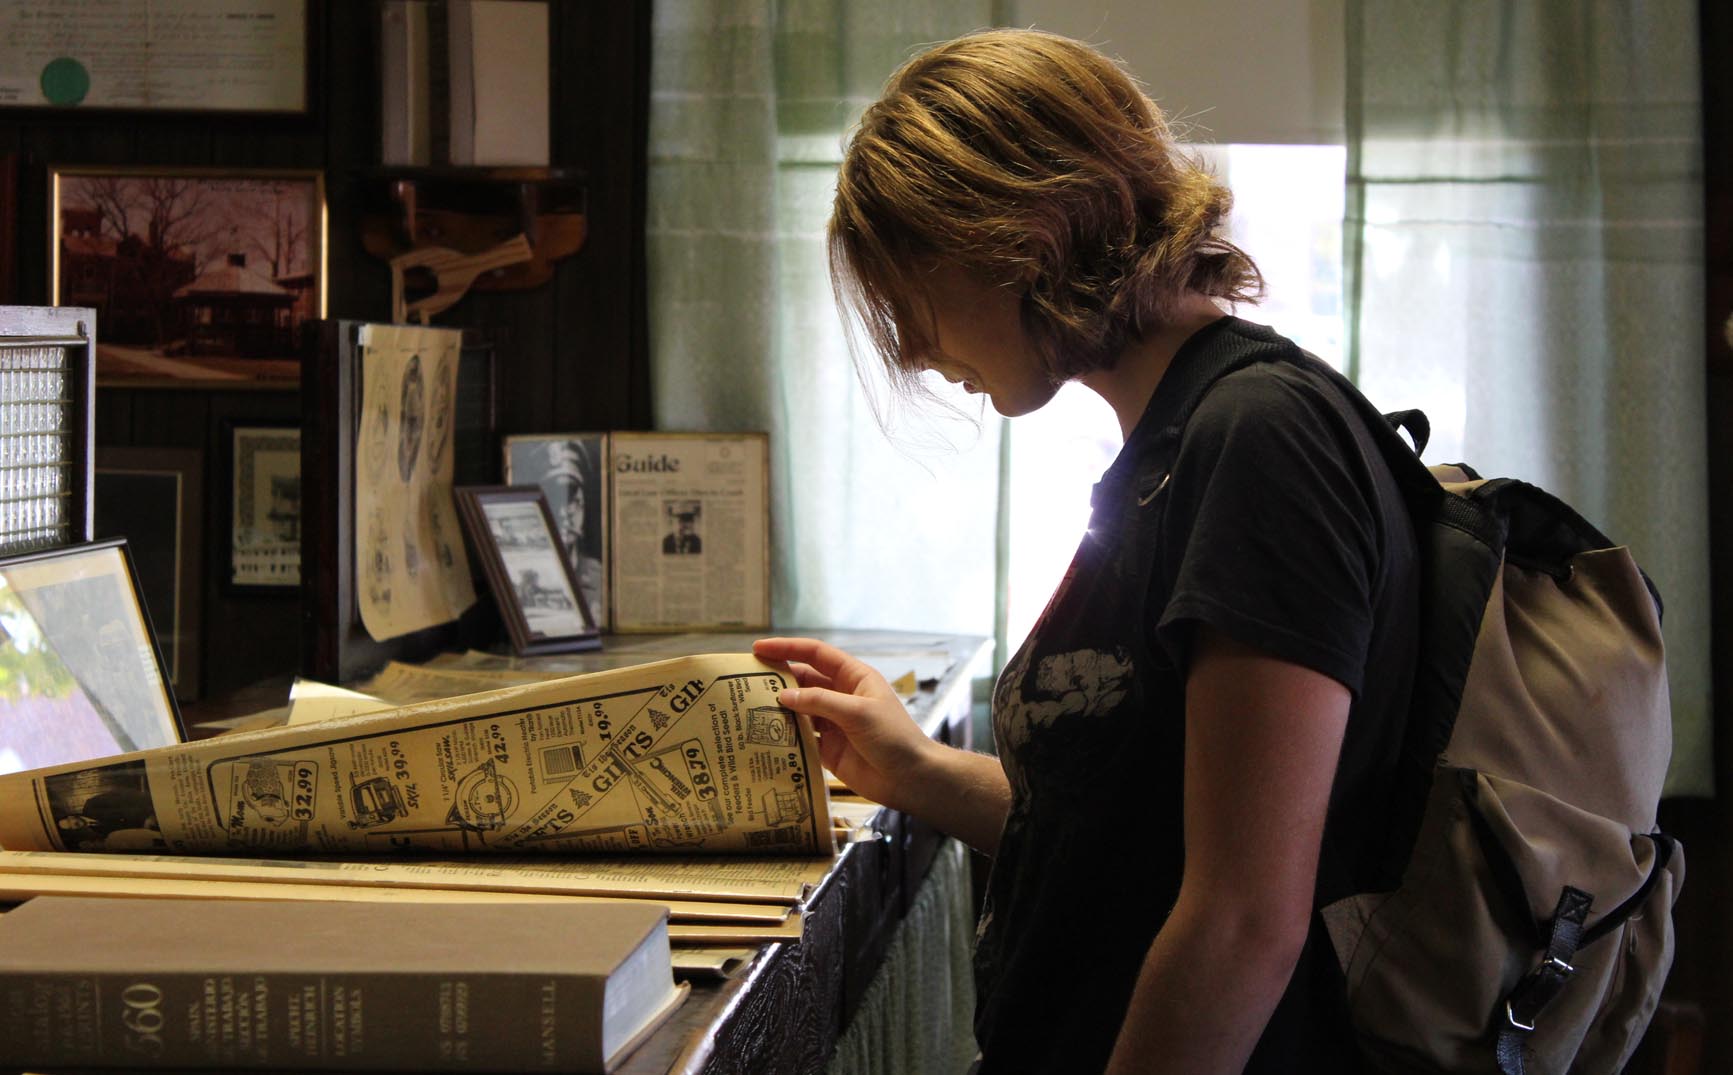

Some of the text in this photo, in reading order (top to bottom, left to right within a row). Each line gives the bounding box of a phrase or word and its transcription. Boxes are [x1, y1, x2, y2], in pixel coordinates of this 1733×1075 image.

[616, 453, 680, 473] Guide
[727, 681, 739, 712] Sunflower
[735, 678, 745, 703] Wild Bird
[742, 677, 751, 693] Seed
[530, 733, 537, 741] by
[593, 702, 612, 742] 19.99
[719, 710, 730, 735] Seed!
[733, 713, 743, 731] Black
[490, 724, 509, 764] 42.99
[519, 718, 537, 794] Portable Electric Heater
[724, 736, 733, 753] Bird
[390, 741, 410, 780] 39.99
[708, 703, 734, 825] See our complete selection of
[727, 755, 737, 773] Wild
[295, 768, 312, 819] 32.99
[328, 747, 346, 820] Variable Speed Jigsaw
[406, 783, 419, 809] SKIL
[733, 783, 743, 814] Feeders
[628, 829, 640, 844] OFF
[121, 983, 164, 1058] 560
[334, 987, 346, 1056] LOCATION
[349, 988, 363, 1053] SYMBOLS
[541, 981, 555, 1065] MANSELL
